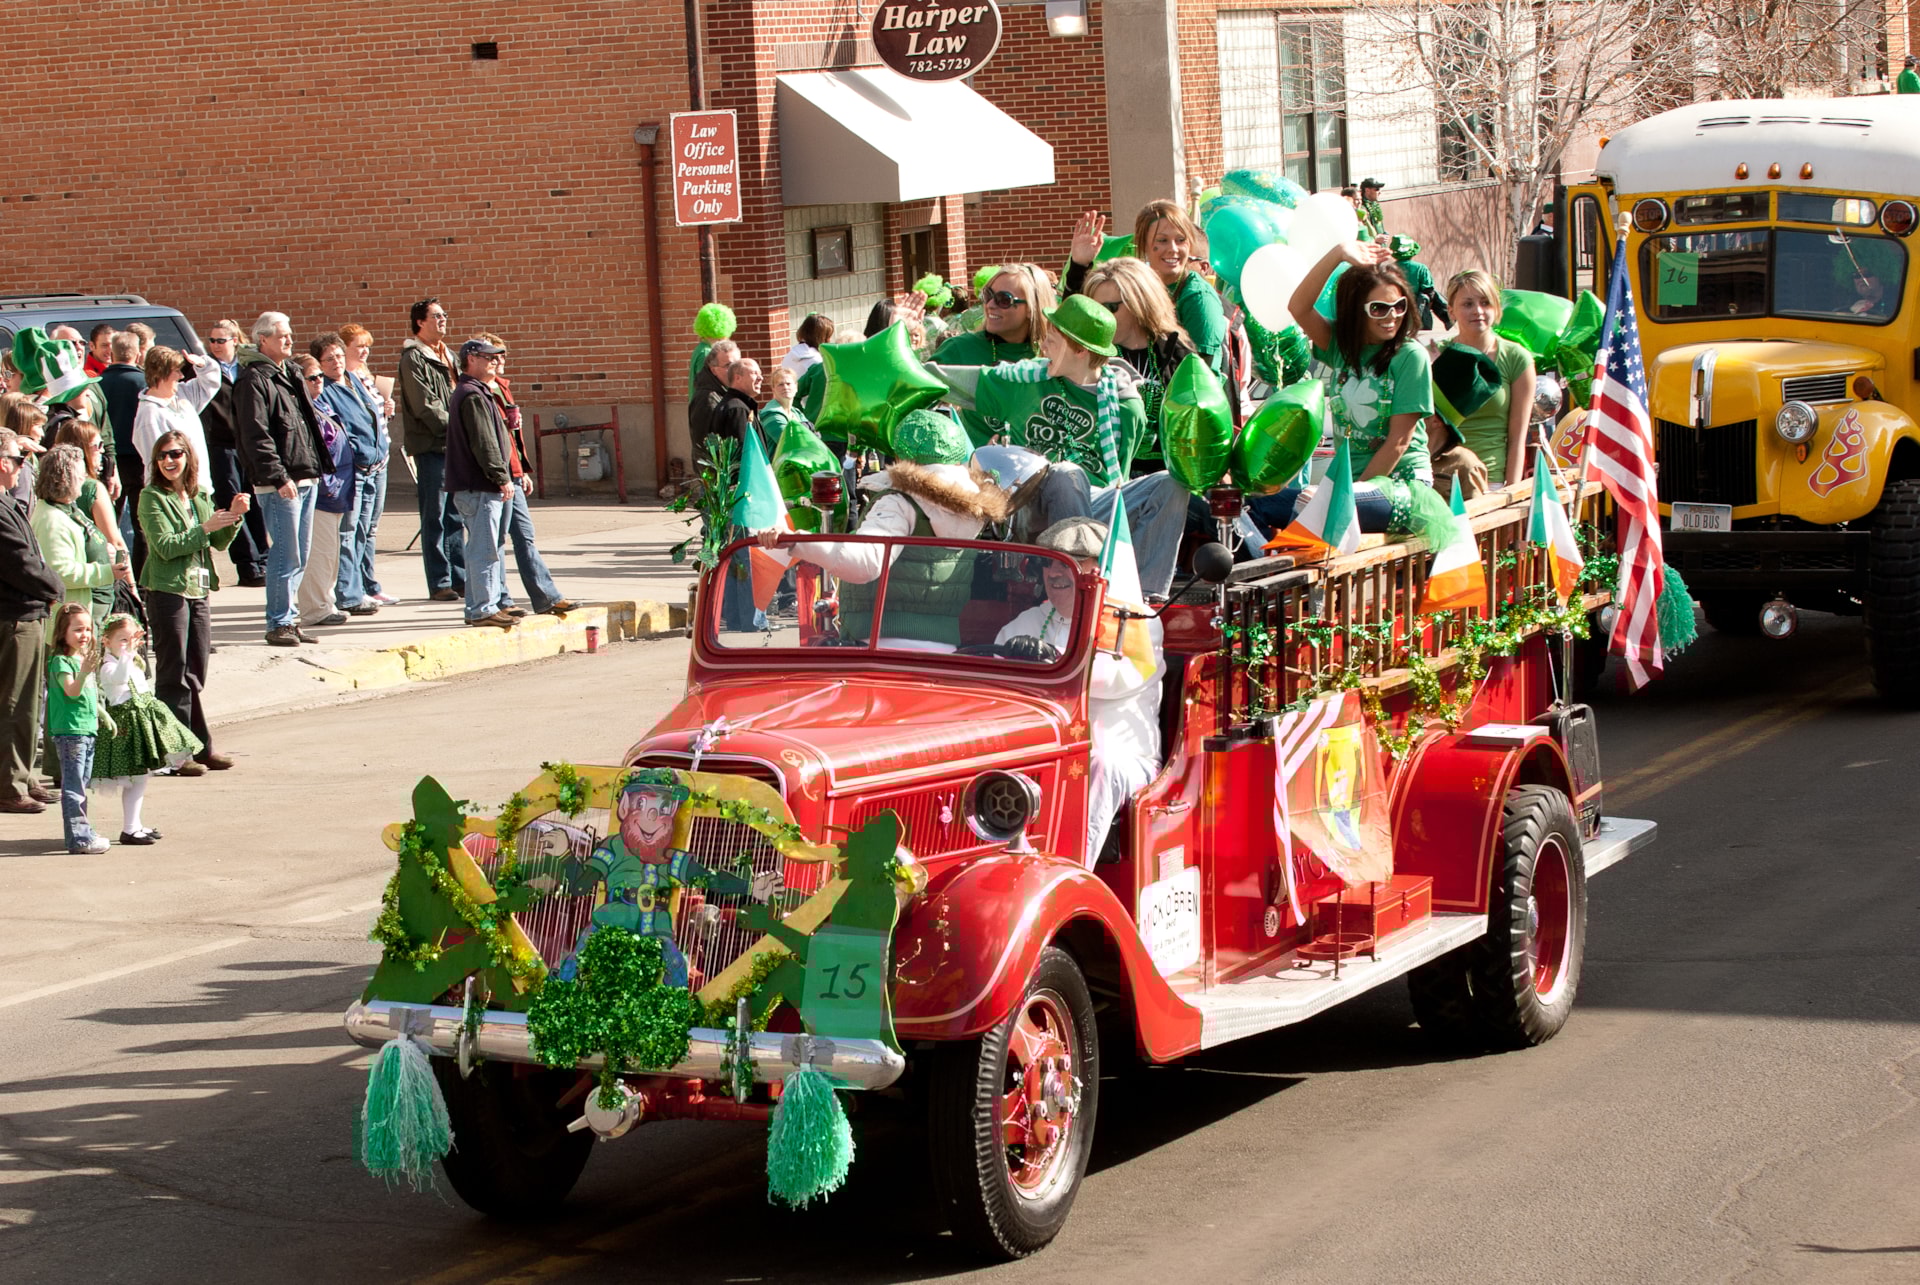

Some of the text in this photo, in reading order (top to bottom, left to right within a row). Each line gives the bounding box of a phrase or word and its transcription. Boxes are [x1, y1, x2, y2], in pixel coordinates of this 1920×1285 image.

[881, 5, 988, 32] Harper
[905, 32, 967, 57] Law
[909, 57, 972, 73] 782-5729
[690, 124, 717, 139] Law
[684, 142, 725, 159] Office
[677, 159, 734, 177] Personnel
[682, 180, 732, 199] Parking
[693, 199, 723, 216] Only
[1637, 209, 1662, 222] STOP
[1663, 266, 1689, 285] 16
[1056, 404, 1091, 428] FOUND
[1031, 423, 1055, 442] TO
[1683, 513, 1720, 529] OLD BUS
[818, 963, 868, 1001] 15
